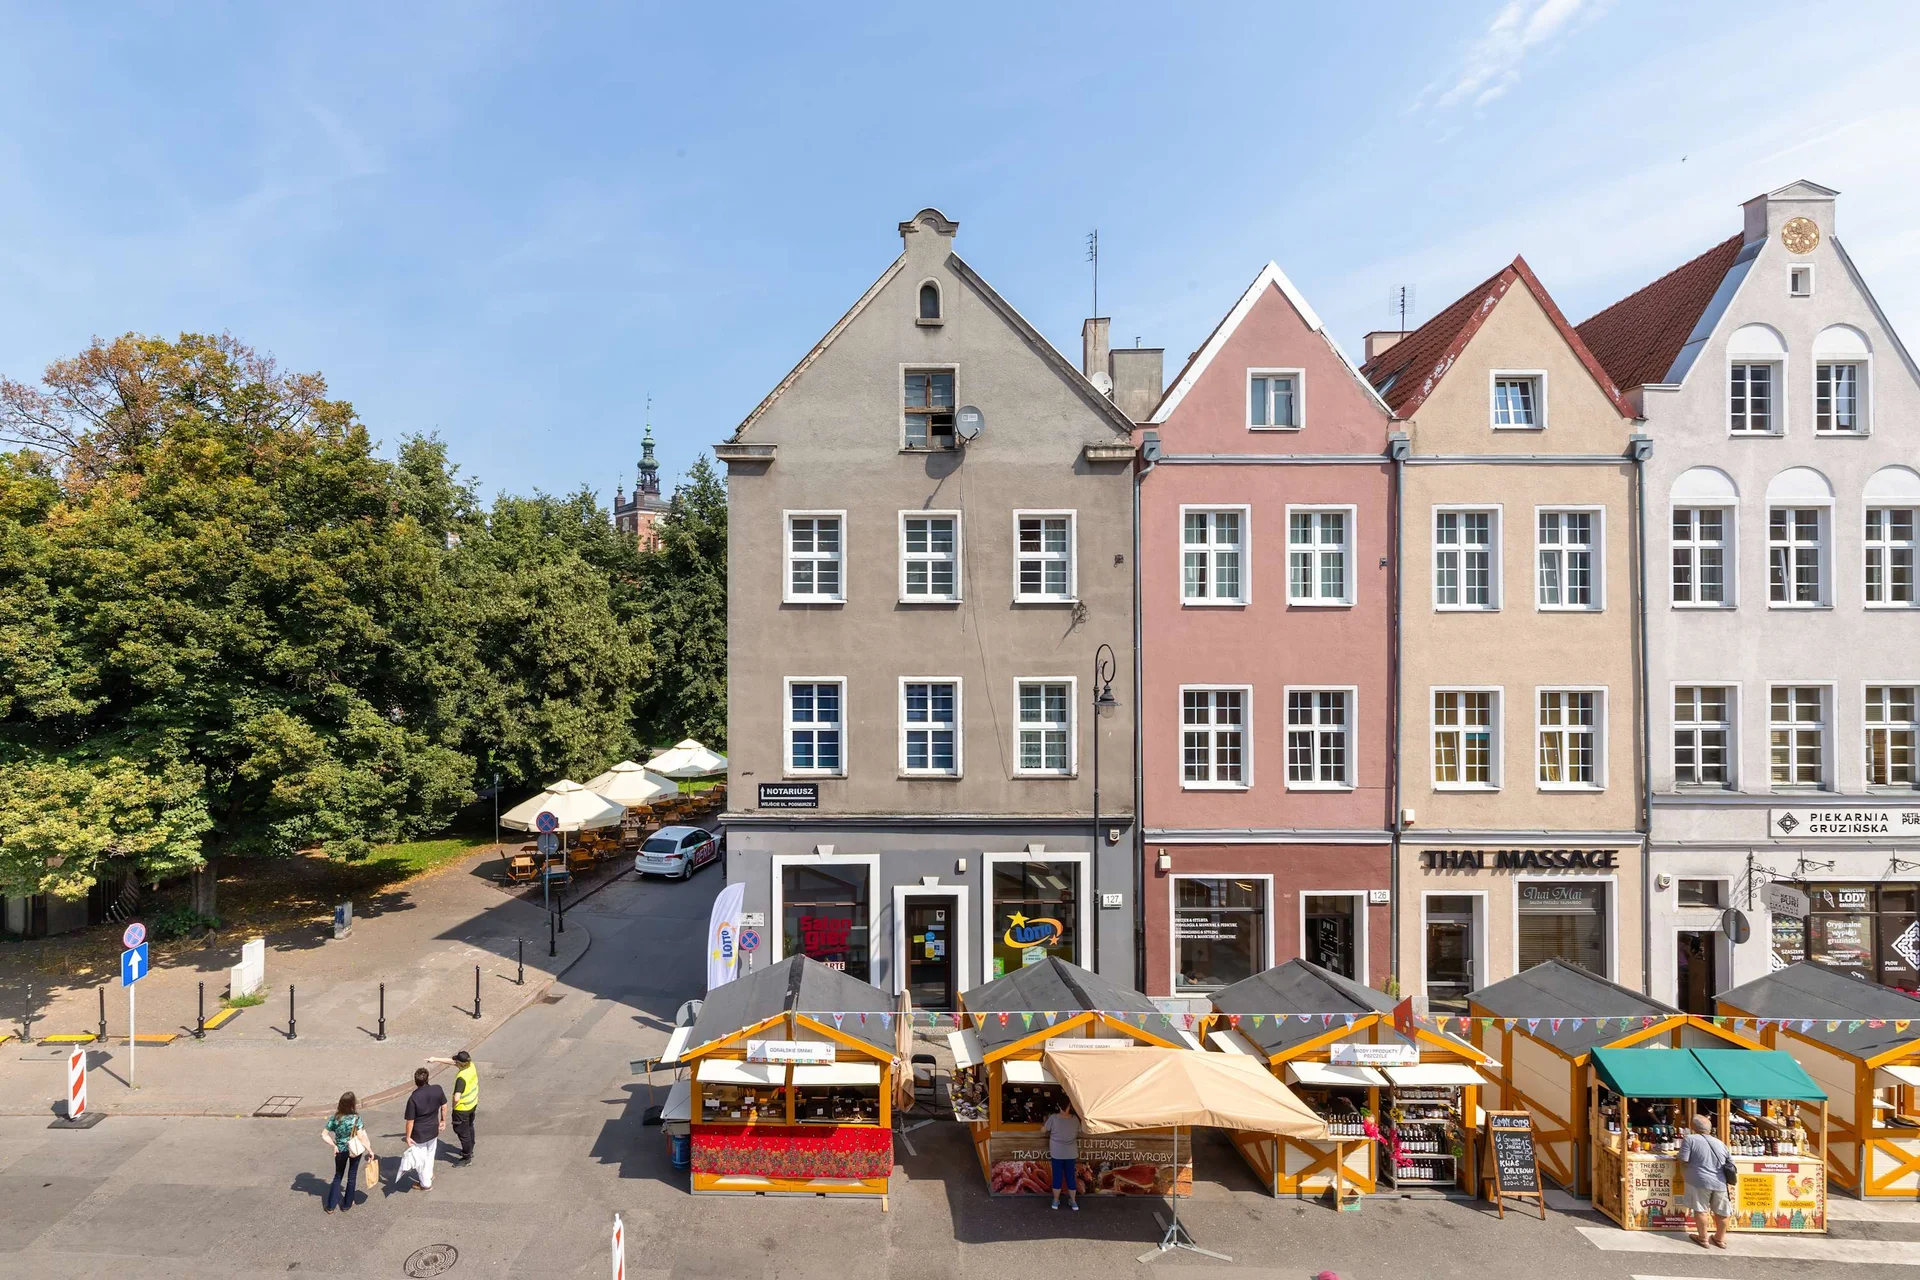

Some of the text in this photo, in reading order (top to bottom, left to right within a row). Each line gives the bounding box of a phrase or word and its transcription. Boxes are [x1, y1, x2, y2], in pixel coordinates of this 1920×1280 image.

[1810, 813, 1889, 822] PIEKARNIA
[1809, 823, 1889, 833] GRUZIŃSKA
[1423, 850, 1620, 869] THAI MASSAGE
[1373, 891, 1387, 900] 126
[1523, 886, 1582, 900] Thai Mai
[1838, 893, 1866, 902] LODY
[1106, 895, 1120, 904] 127
[800, 915, 852, 931] Salon
[1826, 921, 1862, 929] Oryginalne
[1015, 924, 1052, 942] LOTTO
[721, 930, 733, 958] LOTTO
[805, 931, 850, 950] gier
[824, 962, 845, 970] ARTE
[1083, 1139, 1136, 1149] LITEWSKIE
[1012, 1150, 1174, 1162] TRADYC LITEWSKIE WYROBY
[1635, 1178, 1670, 1188] BETTER
